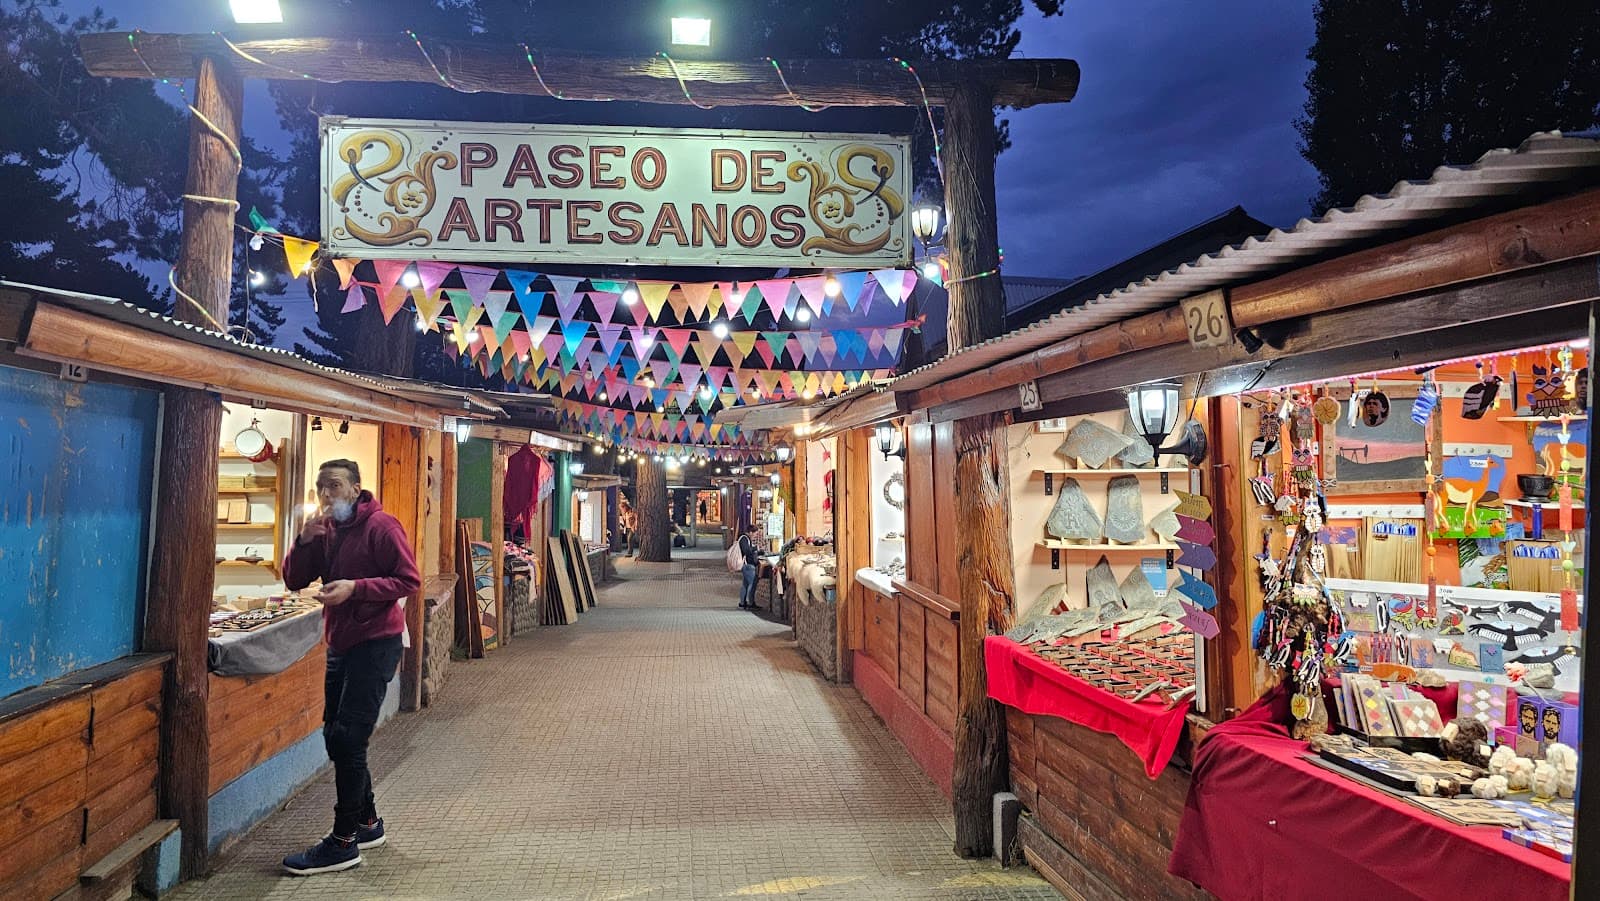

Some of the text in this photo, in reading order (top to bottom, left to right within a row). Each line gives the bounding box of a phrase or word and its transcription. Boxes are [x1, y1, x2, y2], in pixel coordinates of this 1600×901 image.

[460, 142, 786, 193] PASEO DE
[437, 197, 806, 249] ARTESANOS
[1189, 302, 1222, 342] 26
[1020, 381, 1035, 406] 25
